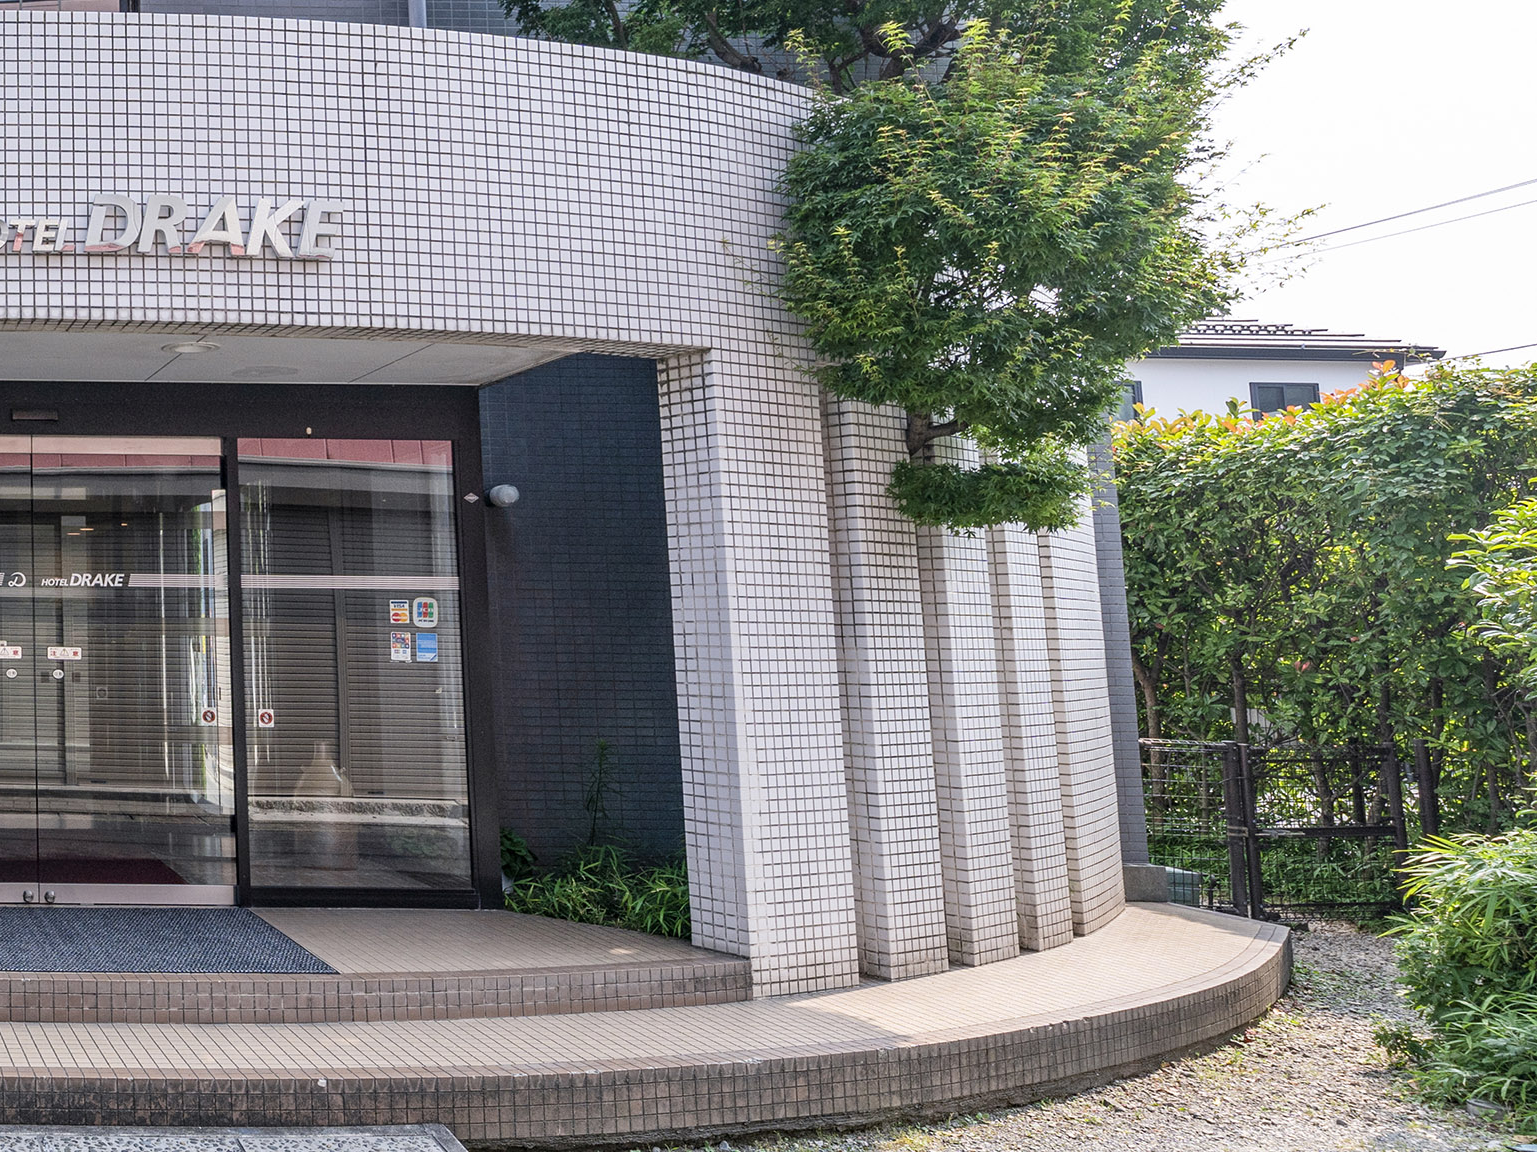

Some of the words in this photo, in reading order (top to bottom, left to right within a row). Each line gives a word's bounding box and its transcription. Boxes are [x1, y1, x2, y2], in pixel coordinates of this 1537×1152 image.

[84, 192, 344, 261] DRAKE
[41, 578, 68, 587] HOTEL
[69, 573, 124, 587] DRAKE
